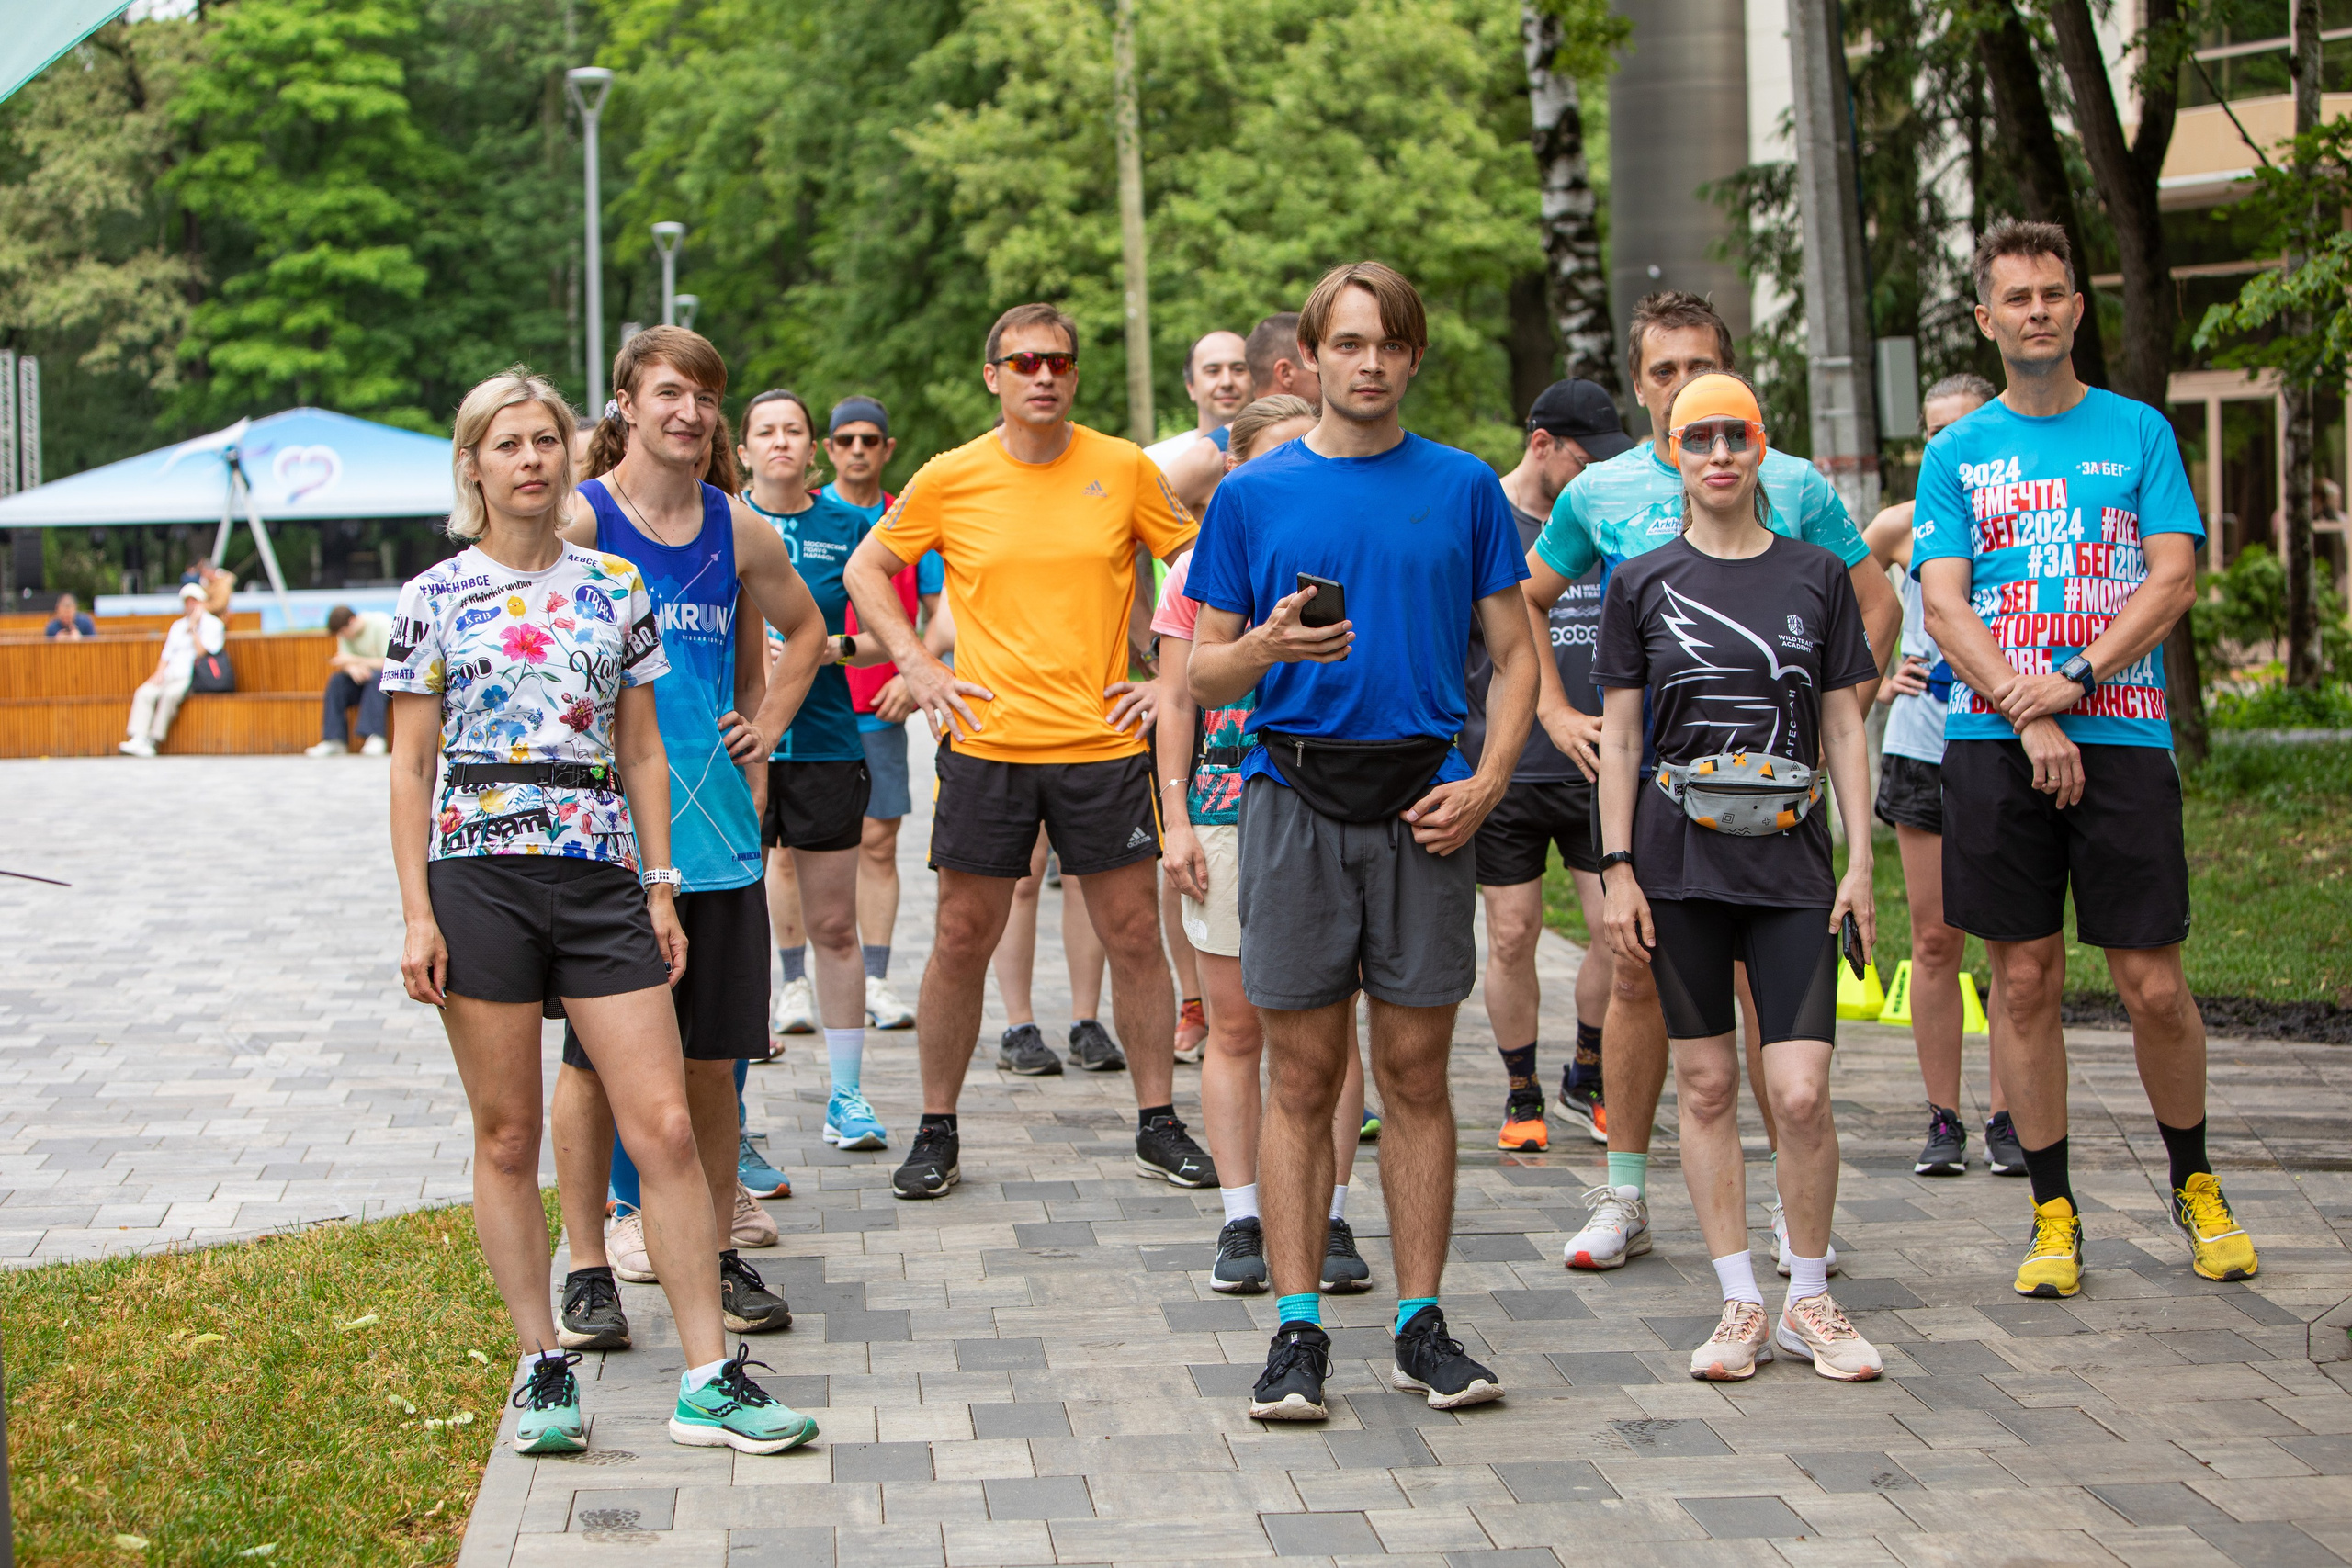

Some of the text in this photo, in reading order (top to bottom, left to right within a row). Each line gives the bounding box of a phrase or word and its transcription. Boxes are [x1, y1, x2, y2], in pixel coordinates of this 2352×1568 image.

[1959, 456, 2021, 491] 2024
[1972, 477, 2068, 522] #МЕЧТА
[1652, 518, 1682, 529] Arkh
[1970, 507, 2085, 558] АБЕГ2024
[2101, 506, 2142, 548] #ЦЕ
[2027, 543, 2151, 583] #ЗАБЕГ202
[419, 574, 491, 596] #УМЕНЯВСЕ
[465, 613, 492, 625] KRB
[1990, 613, 2116, 648] #ГОРДОСТ
[1781, 640, 1812, 653] ACADEMY
